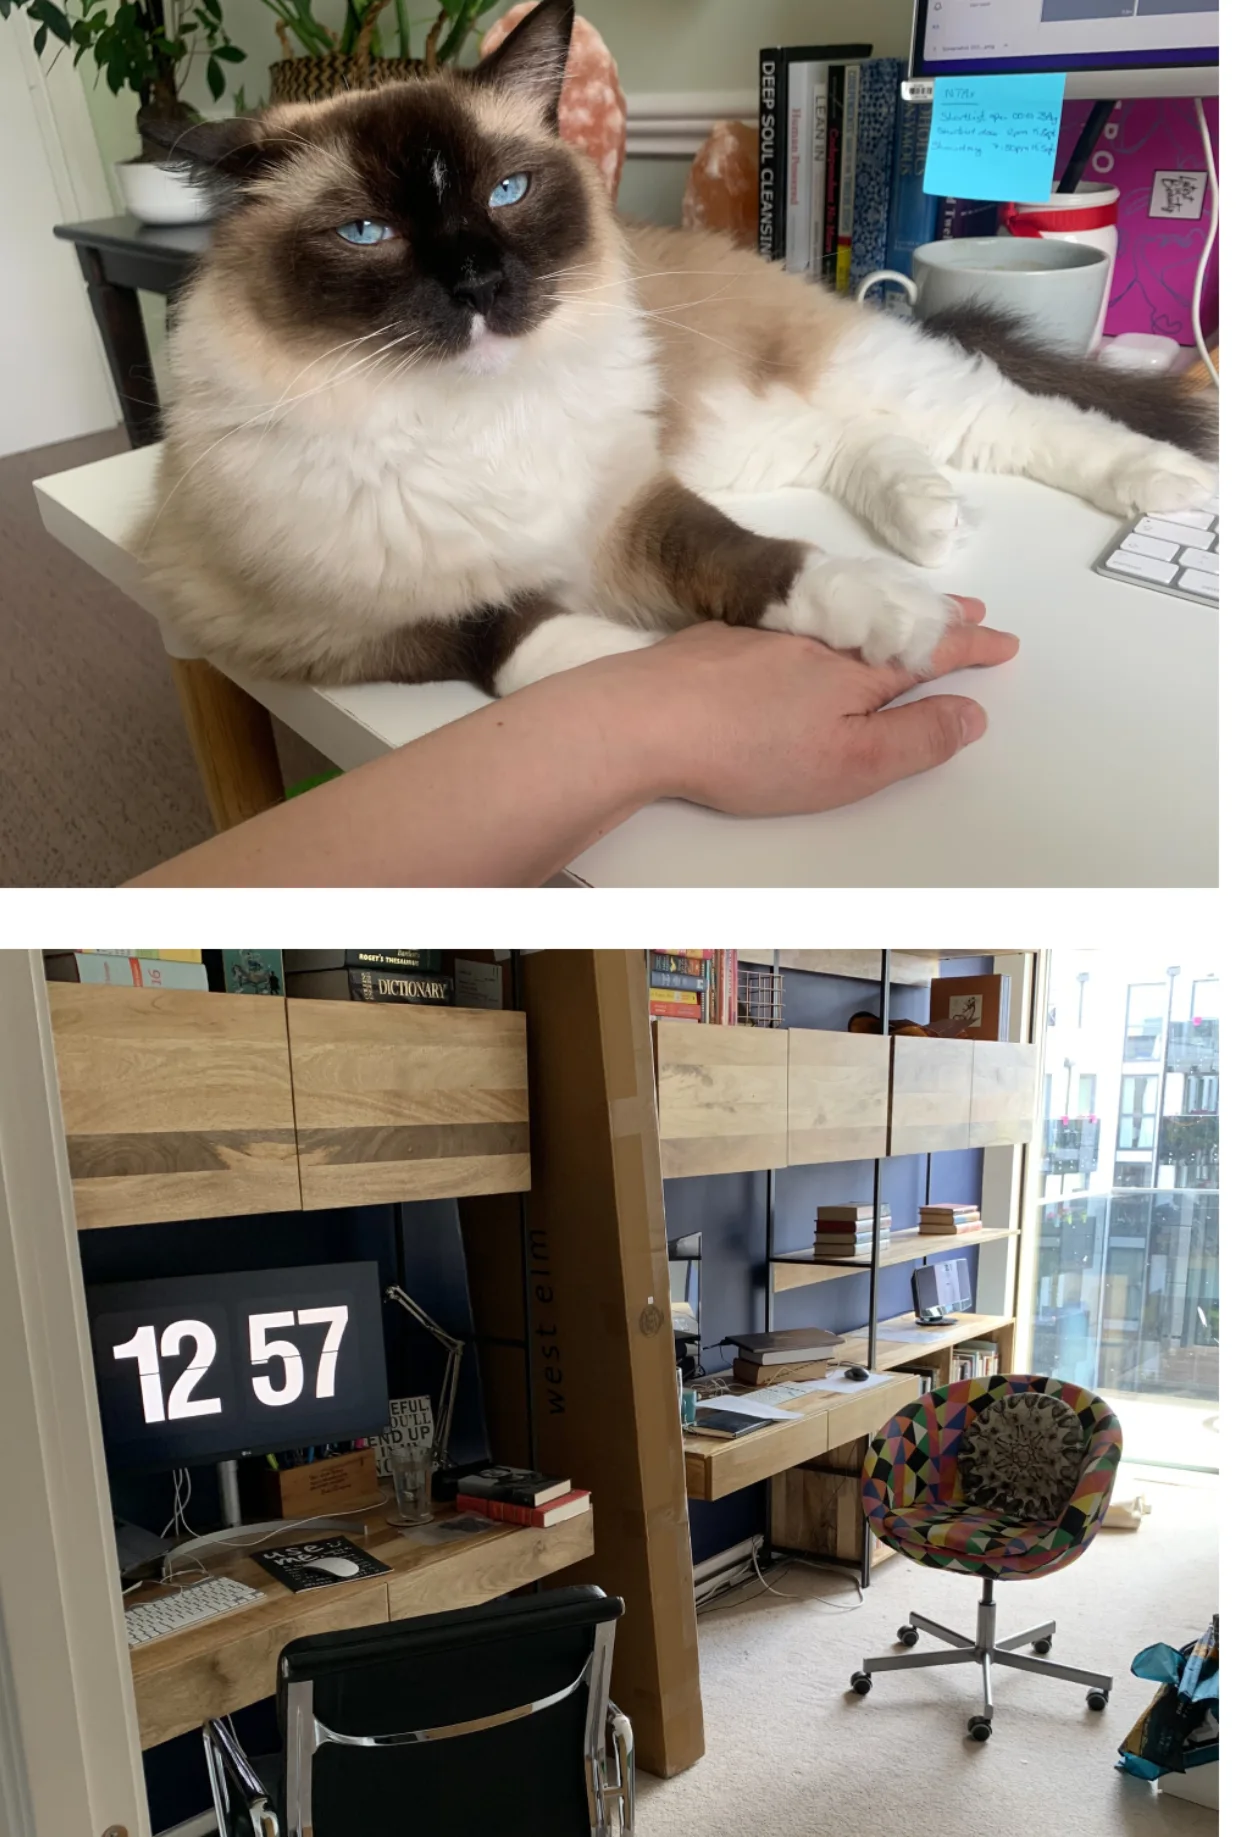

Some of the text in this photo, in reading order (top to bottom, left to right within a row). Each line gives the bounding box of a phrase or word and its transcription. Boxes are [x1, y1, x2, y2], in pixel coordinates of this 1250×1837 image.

[791, 108, 801, 153] Human
[814, 96, 826, 162] LEAN IN
[760, 61, 775, 256] DEEP SOUL CLEANSIN
[828, 128, 839, 198] Codependent
[790, 156, 800, 205] Powered
[943, 209, 956, 239] Twel
[358, 953, 384, 963] ROGET'S
[148, 969, 162, 985] 16
[378, 979, 447, 999] DICTIONARY
[530, 1229, 565, 1415] west elm
[112, 1304, 349, 1424] 12 57
[391, 1399, 429, 1415] EFUL,
[391, 1413, 431, 1428] OU'LL
[367, 1426, 430, 1447] END UP
[263, 1544, 324, 1560] use
[274, 1553, 319, 1566] me
